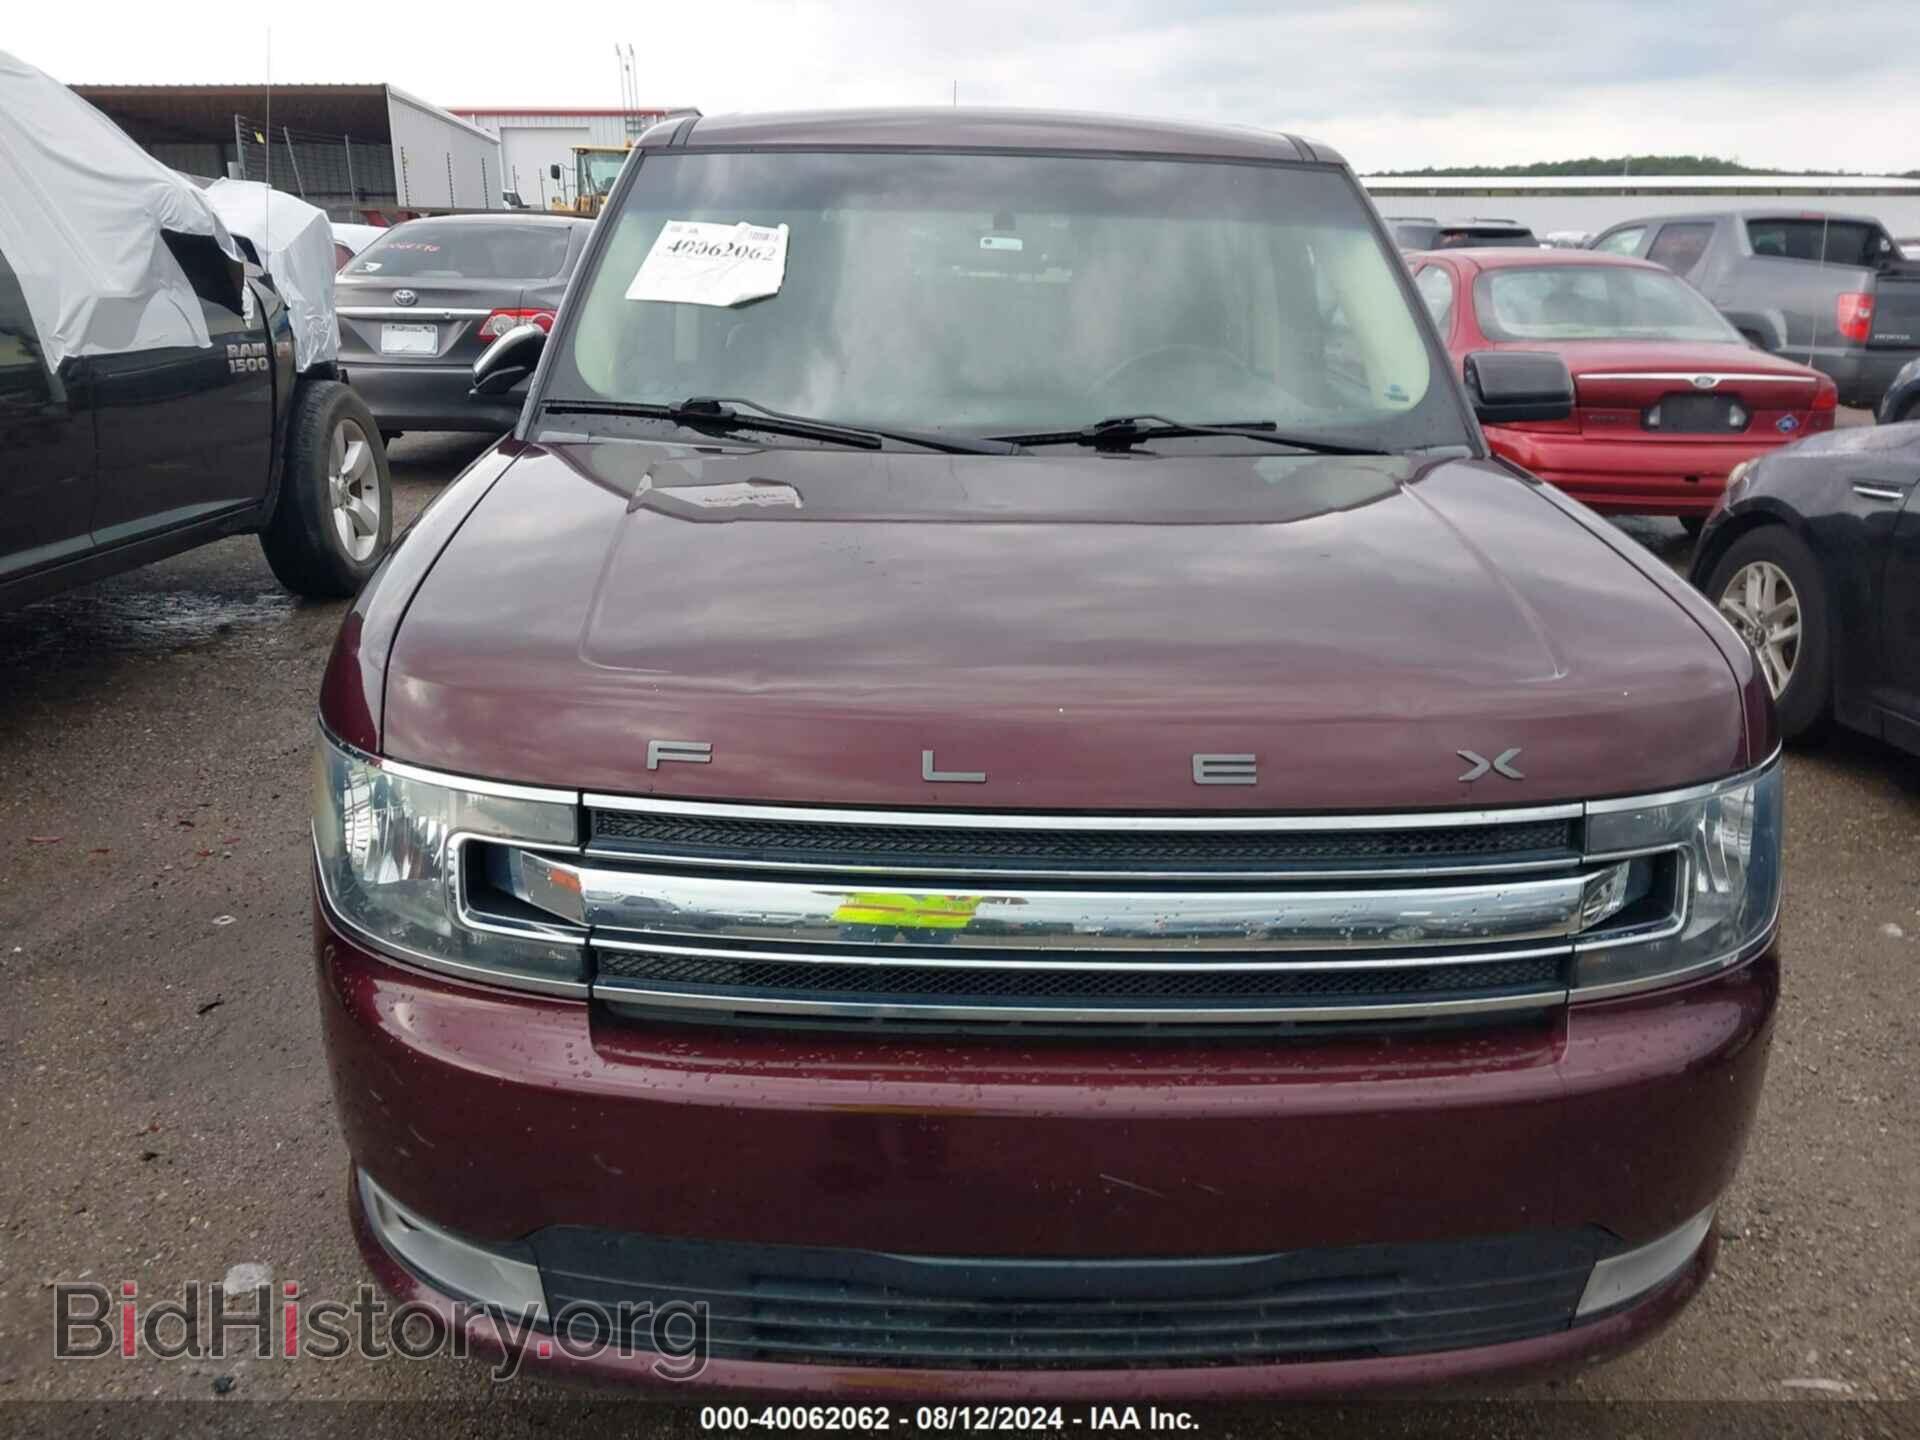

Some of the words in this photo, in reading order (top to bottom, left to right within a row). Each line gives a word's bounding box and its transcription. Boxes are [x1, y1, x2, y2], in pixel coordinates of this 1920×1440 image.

[226, 342, 268, 358] RAM
[228, 356, 270, 374] 1500
[646, 739, 1526, 785] FLEX
